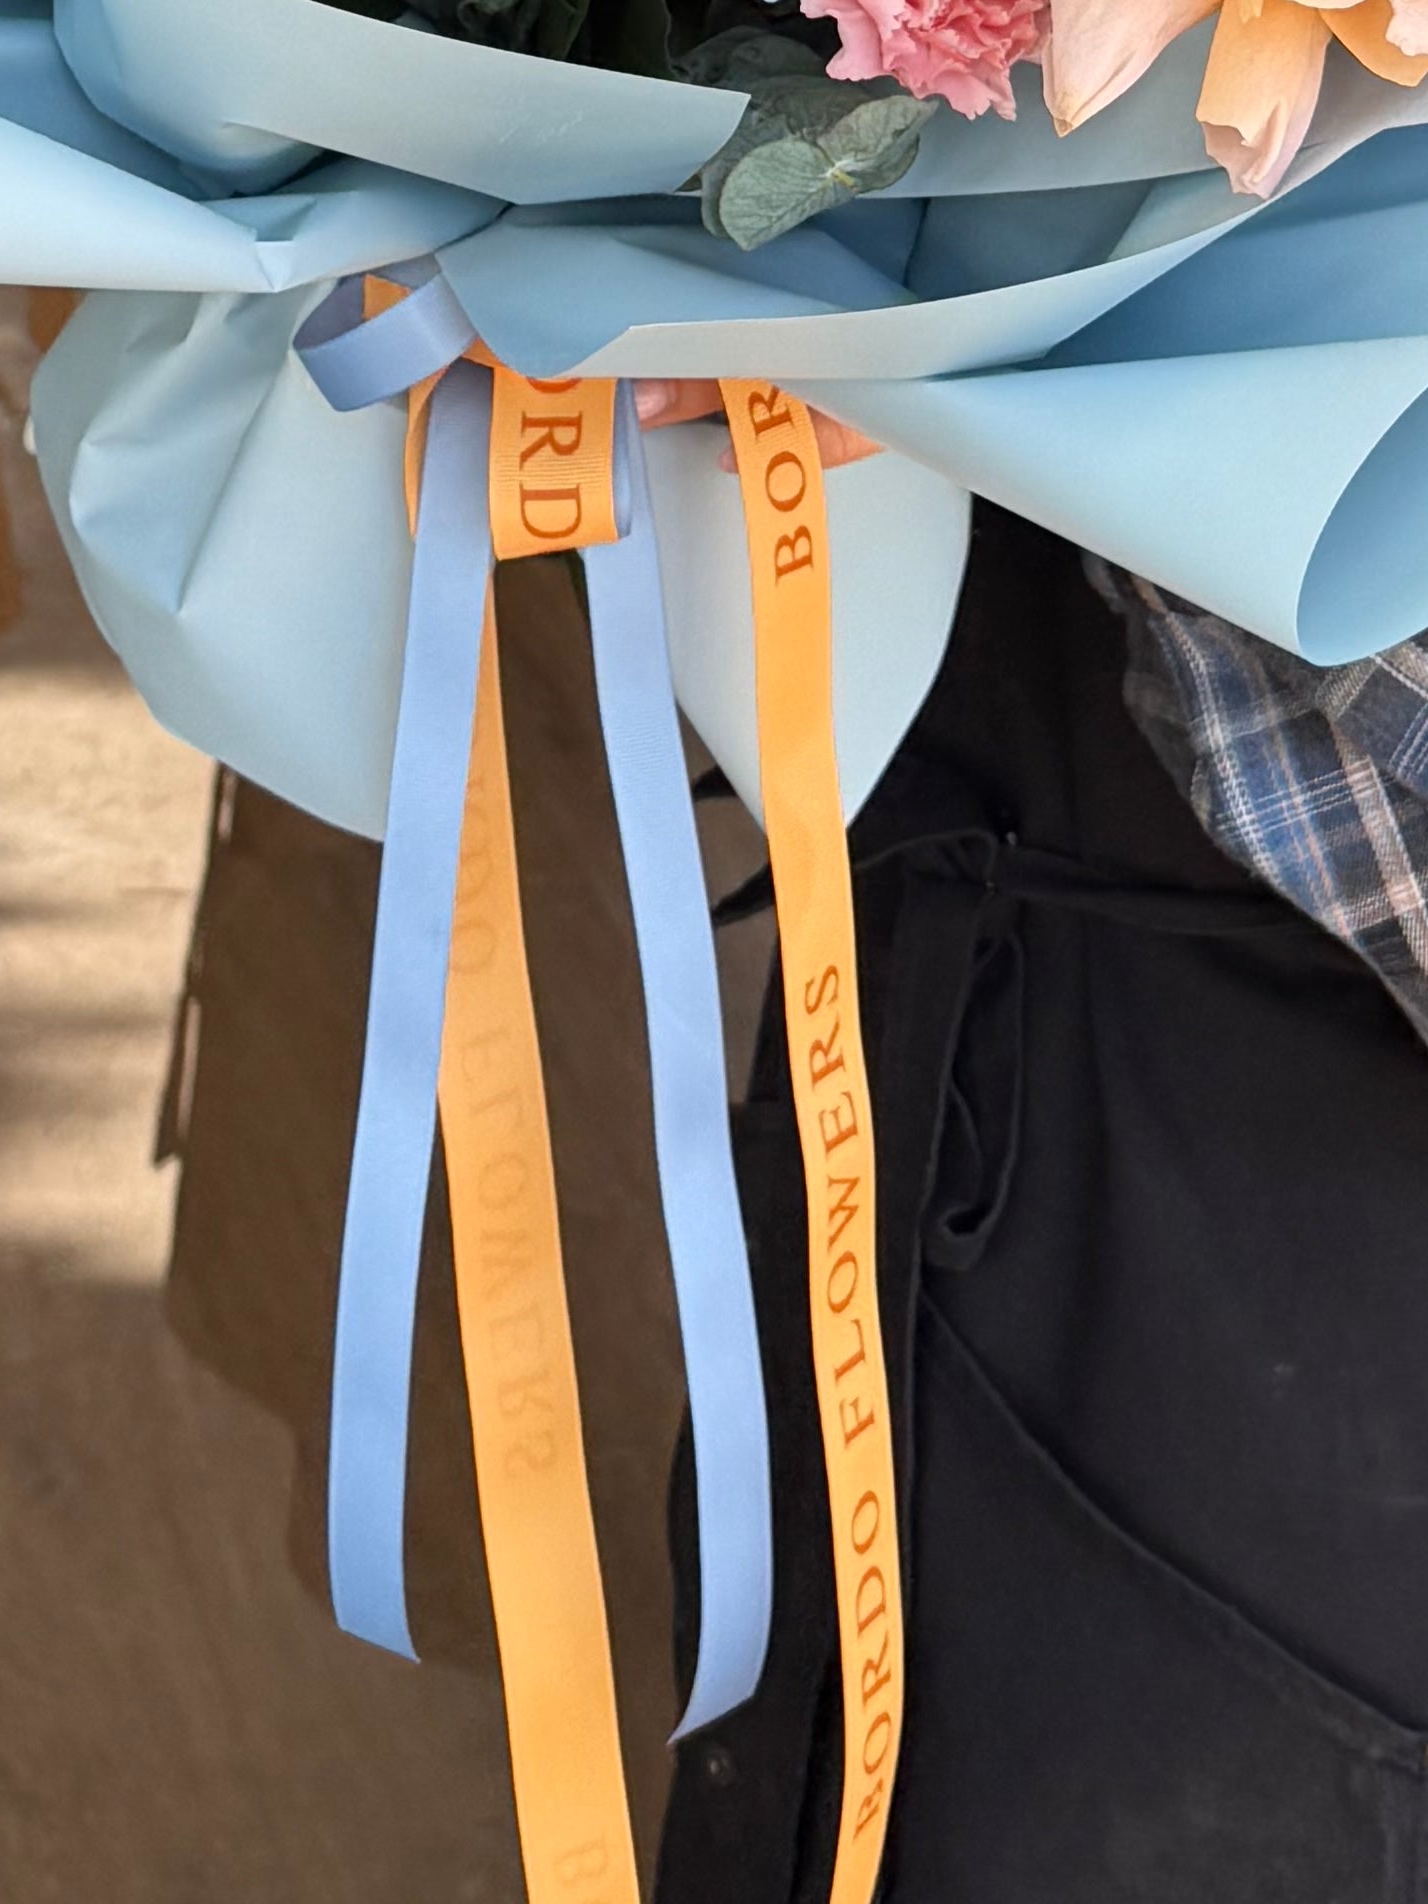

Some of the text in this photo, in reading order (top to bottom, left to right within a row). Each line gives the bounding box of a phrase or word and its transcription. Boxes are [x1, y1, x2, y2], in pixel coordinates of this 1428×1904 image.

[518, 377, 584, 540] RD
[804, 962, 893, 1841] BORDO FLOWERS
